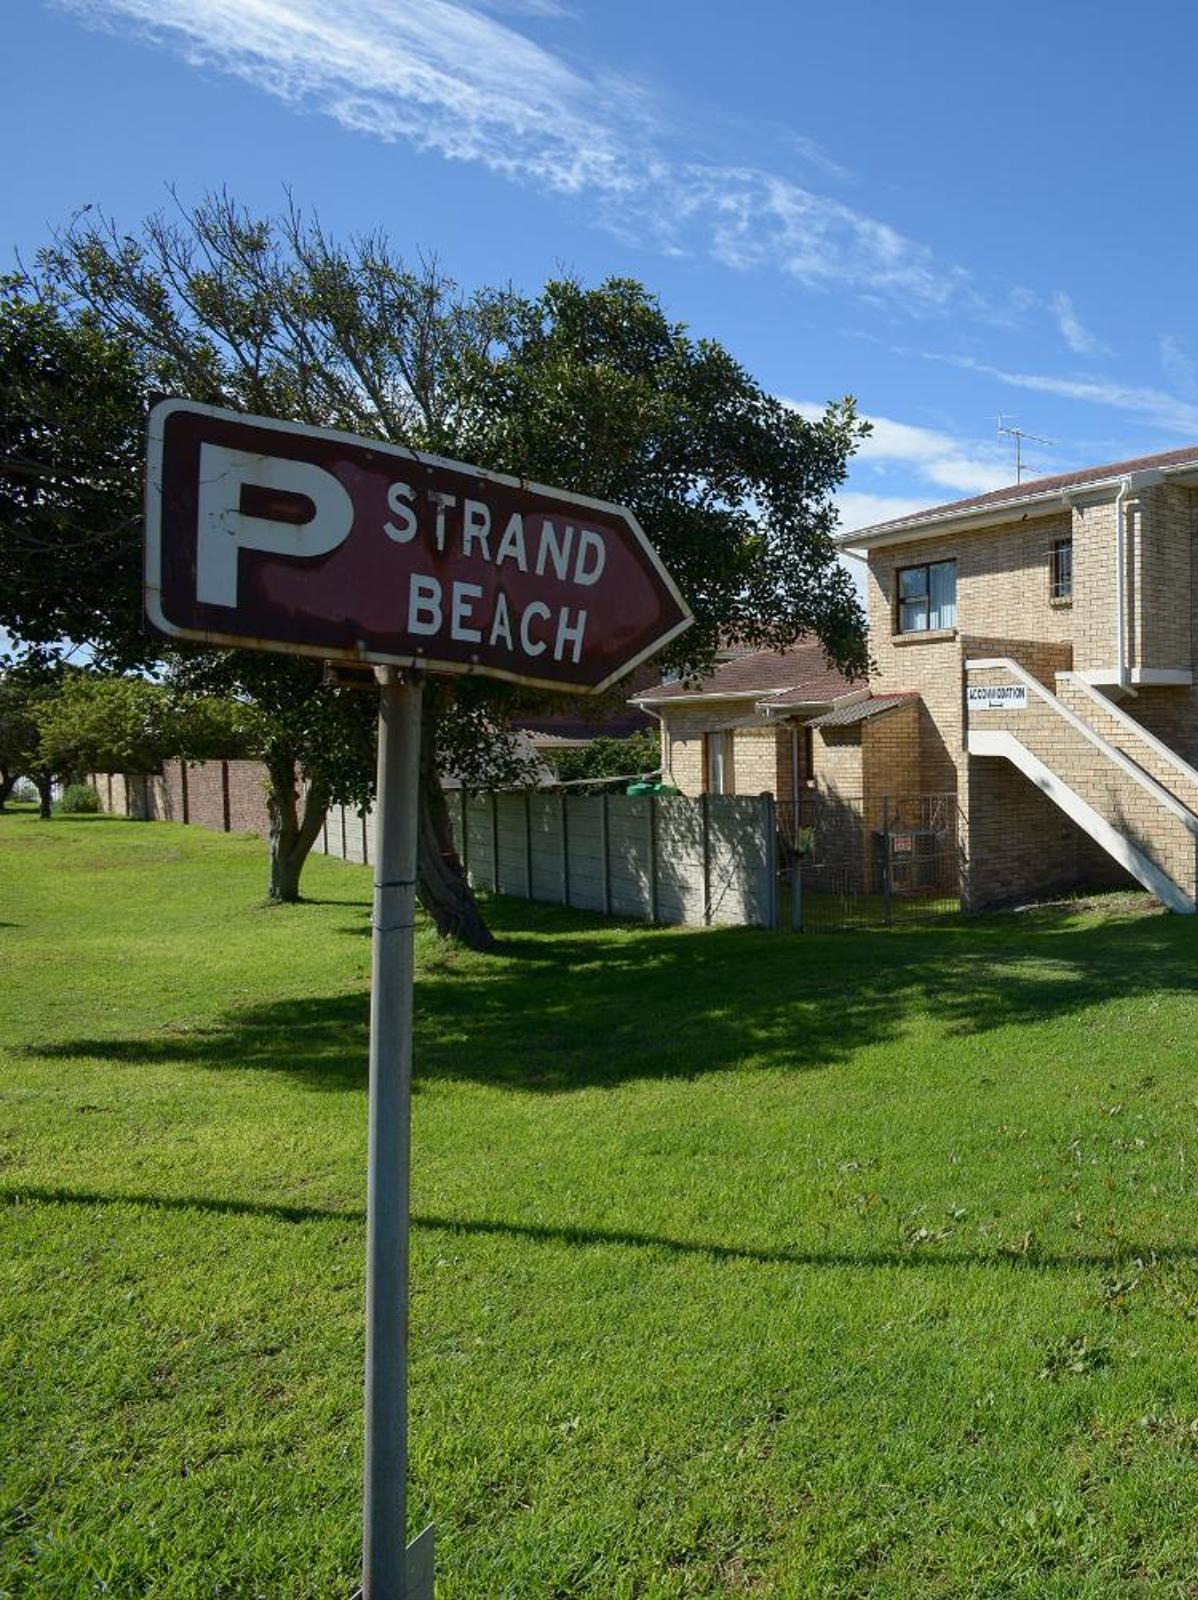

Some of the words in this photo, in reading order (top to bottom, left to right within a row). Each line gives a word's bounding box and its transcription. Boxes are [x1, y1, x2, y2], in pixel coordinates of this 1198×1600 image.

[195, 442, 355, 609] P
[383, 482, 607, 587] STRAND
[406, 573, 587, 664] BEACH
